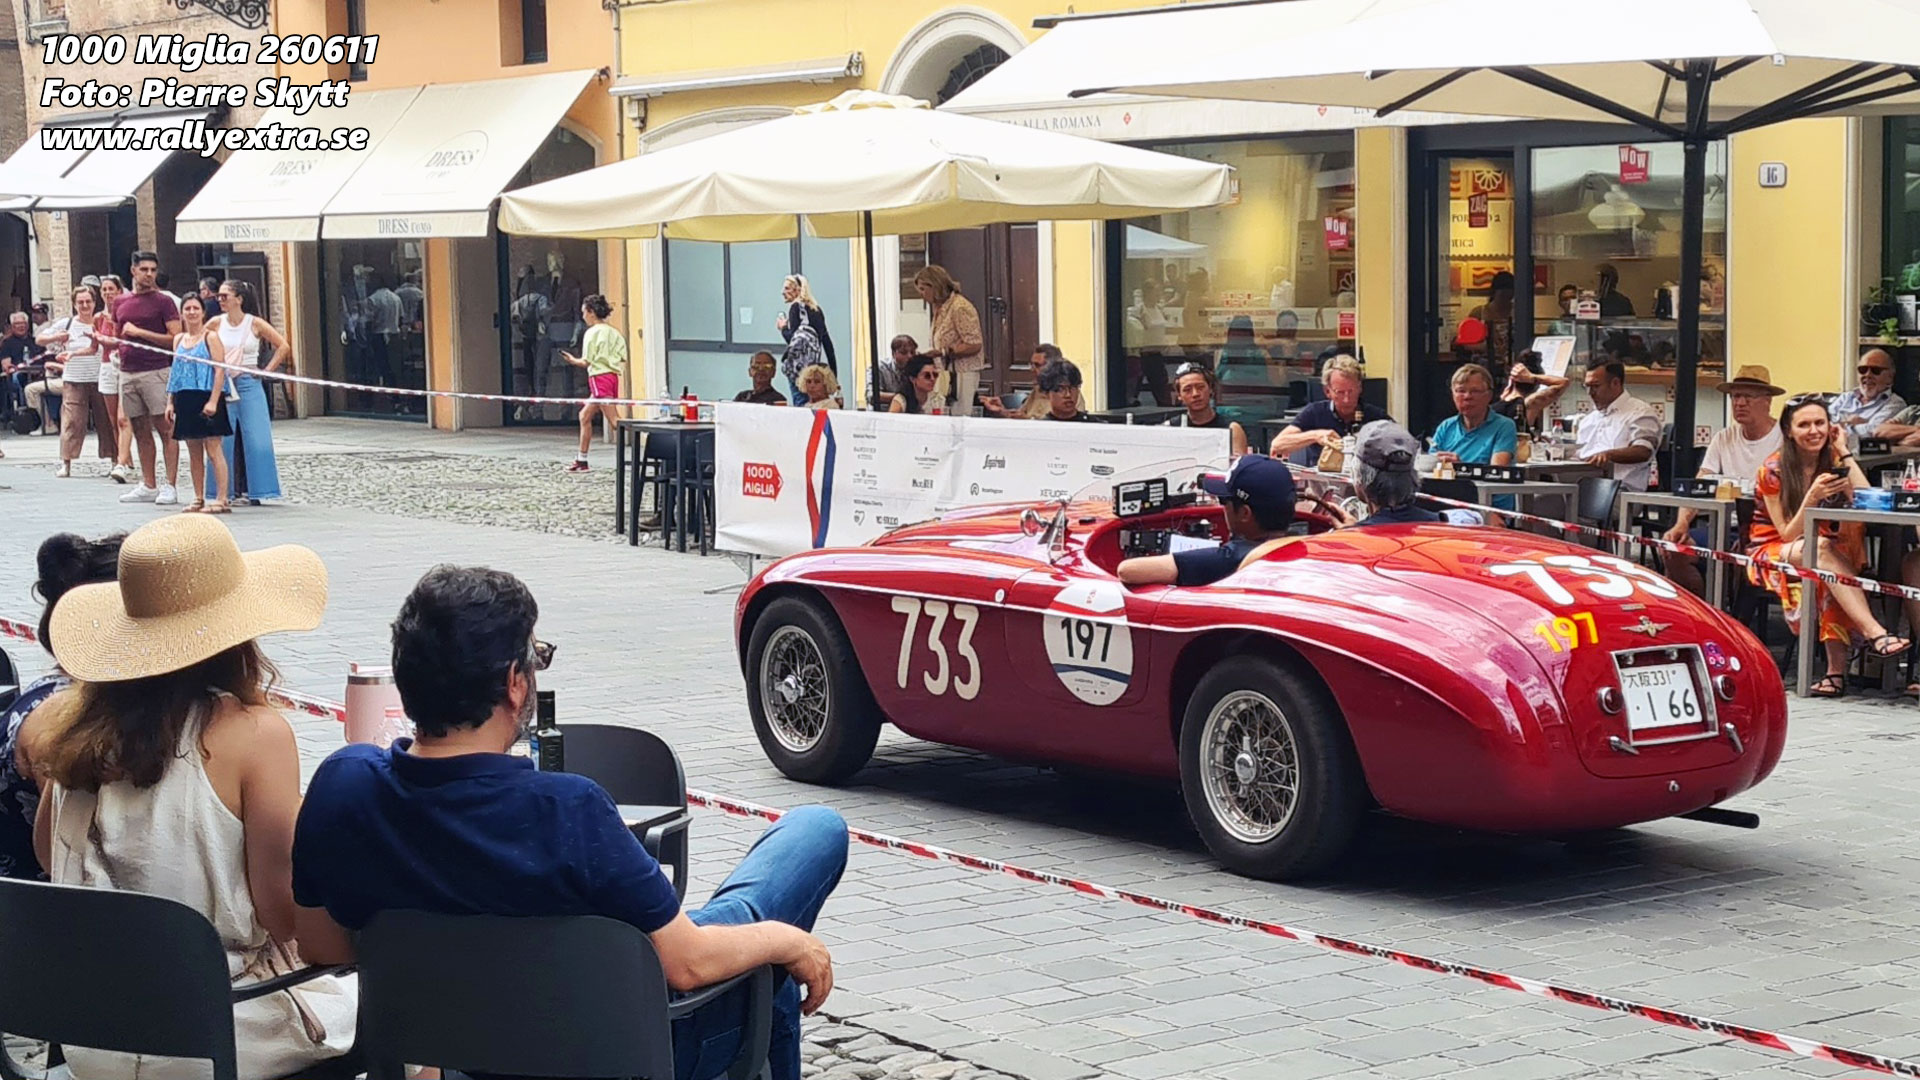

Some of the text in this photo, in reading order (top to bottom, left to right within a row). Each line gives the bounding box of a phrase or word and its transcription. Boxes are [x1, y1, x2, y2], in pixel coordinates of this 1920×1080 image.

[1052, 114, 1102, 129] ROMANA
[1620, 147, 1646, 168] WOW
[1767, 166, 1778, 183] 16
[224, 224, 251, 239] DRESS
[379, 218, 409, 233] DRESS
[1325, 216, 1347, 236] WOW
[746, 465, 773, 479] 1000
[744, 482, 775, 496] MIGLIA
[1490, 556, 1678, 605] 733
[1061, 617, 1113, 662] 197
[1534, 612, 1599, 652] 197
[891, 596, 981, 700] 733
